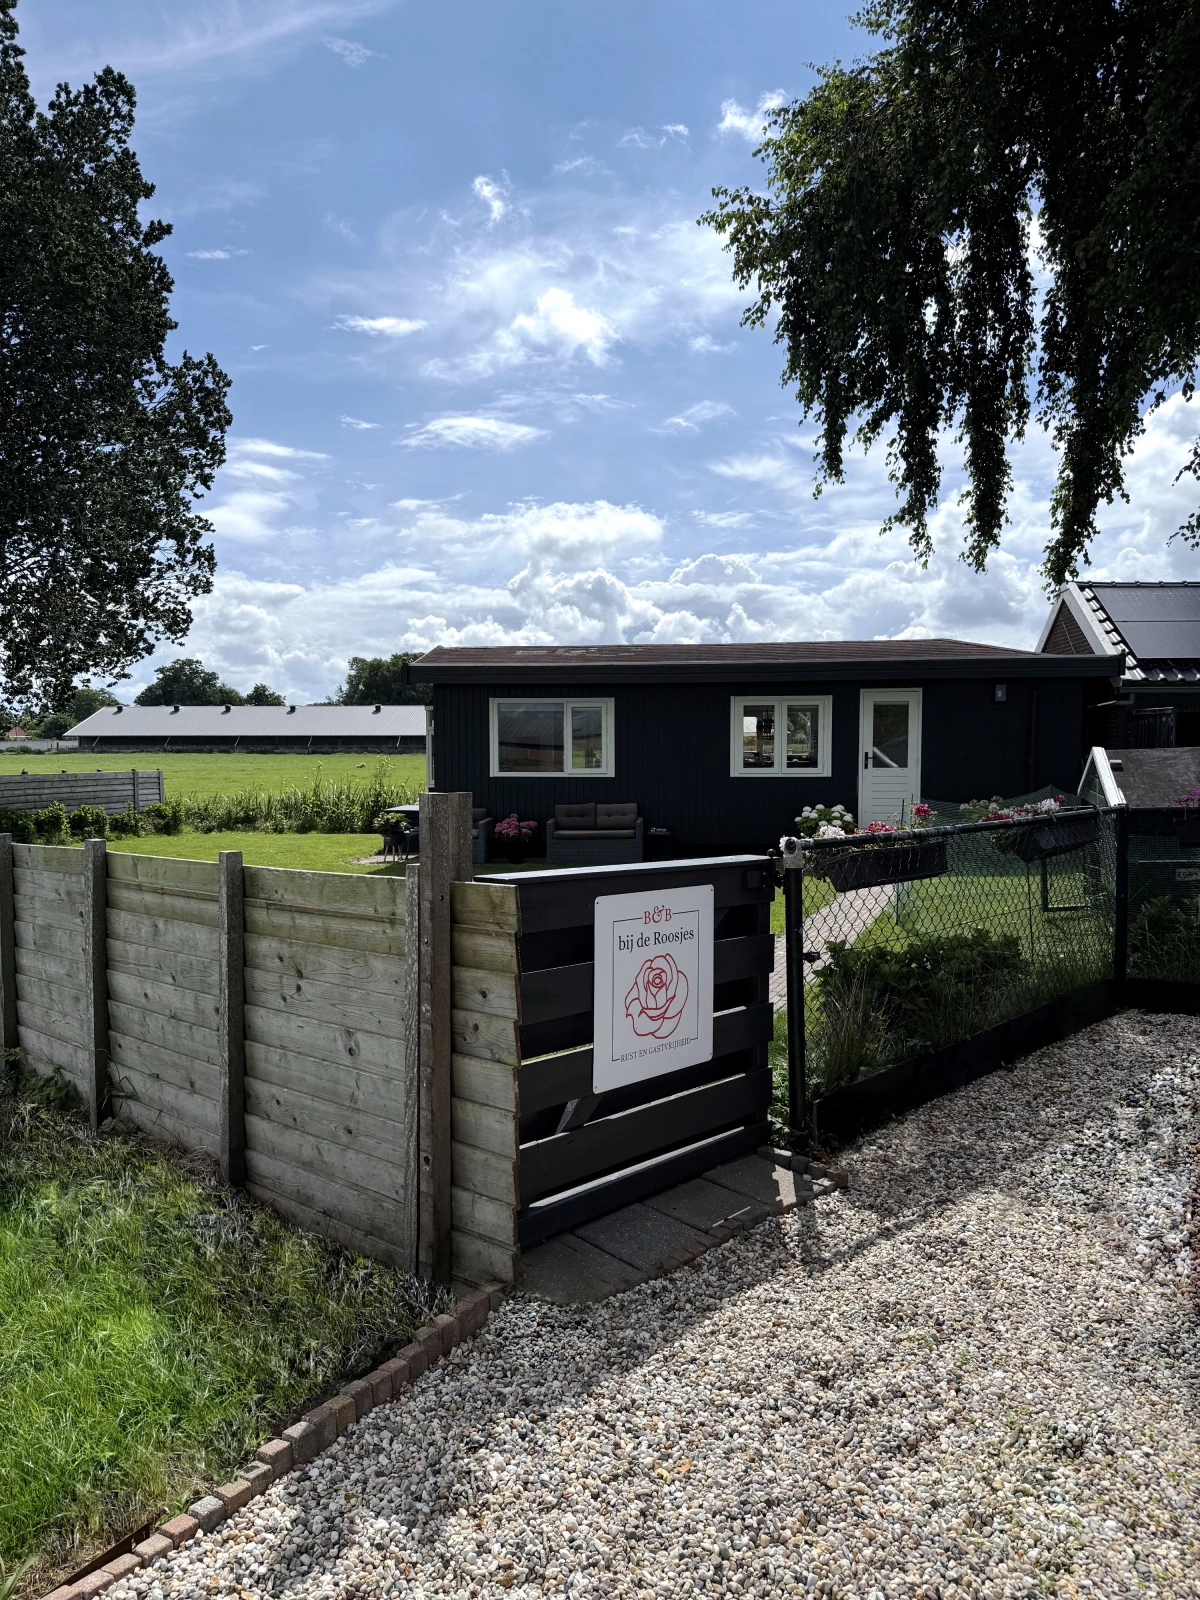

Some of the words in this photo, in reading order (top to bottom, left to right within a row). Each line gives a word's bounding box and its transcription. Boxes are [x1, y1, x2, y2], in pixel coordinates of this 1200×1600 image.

[643, 904, 672, 925] B&B
[618, 934, 634, 954] bij
[636, 932, 651, 948] de
[653, 926, 695, 946] Roosjes
[620, 1051, 638, 1063] RUST
[638, 1048, 648, 1058] EN
[648, 1037, 692, 1055] GASTVRIJHEID
